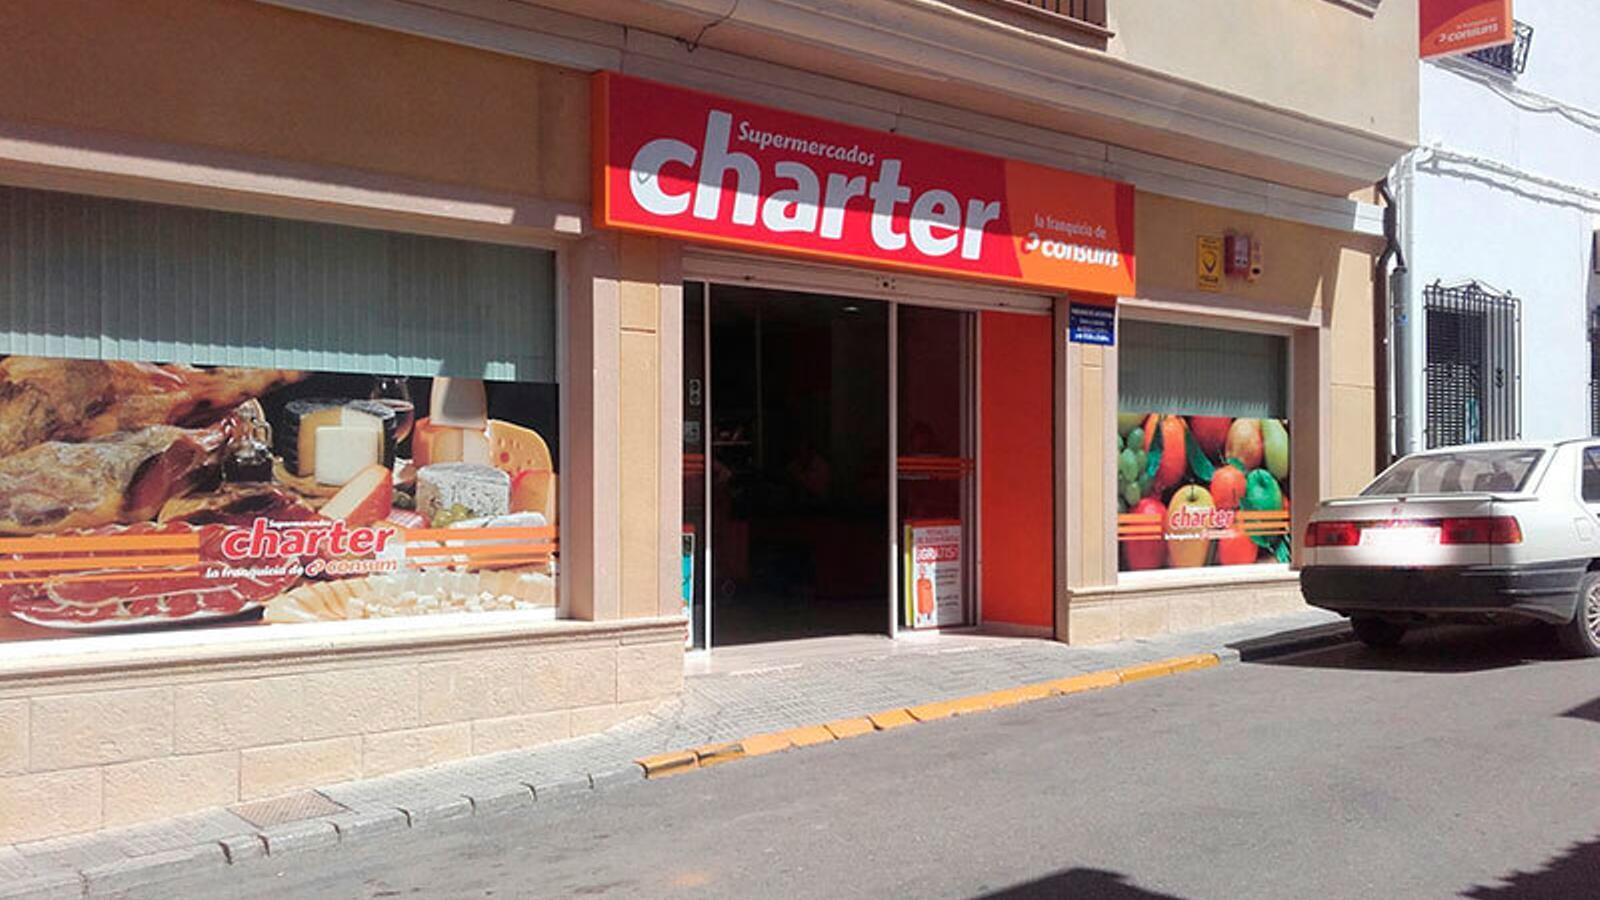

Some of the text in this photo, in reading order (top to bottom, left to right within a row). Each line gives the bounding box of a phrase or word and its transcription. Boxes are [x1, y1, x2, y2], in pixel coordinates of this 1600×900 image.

[738, 121, 876, 166] Supermercados
[628, 111, 1000, 261] charter
[1041, 239, 1119, 267] consum
[1169, 504, 1235, 530] charter
[222, 517, 395, 560] charter
[221, 565, 287, 580] franquicia
[325, 559, 397, 575] consum
